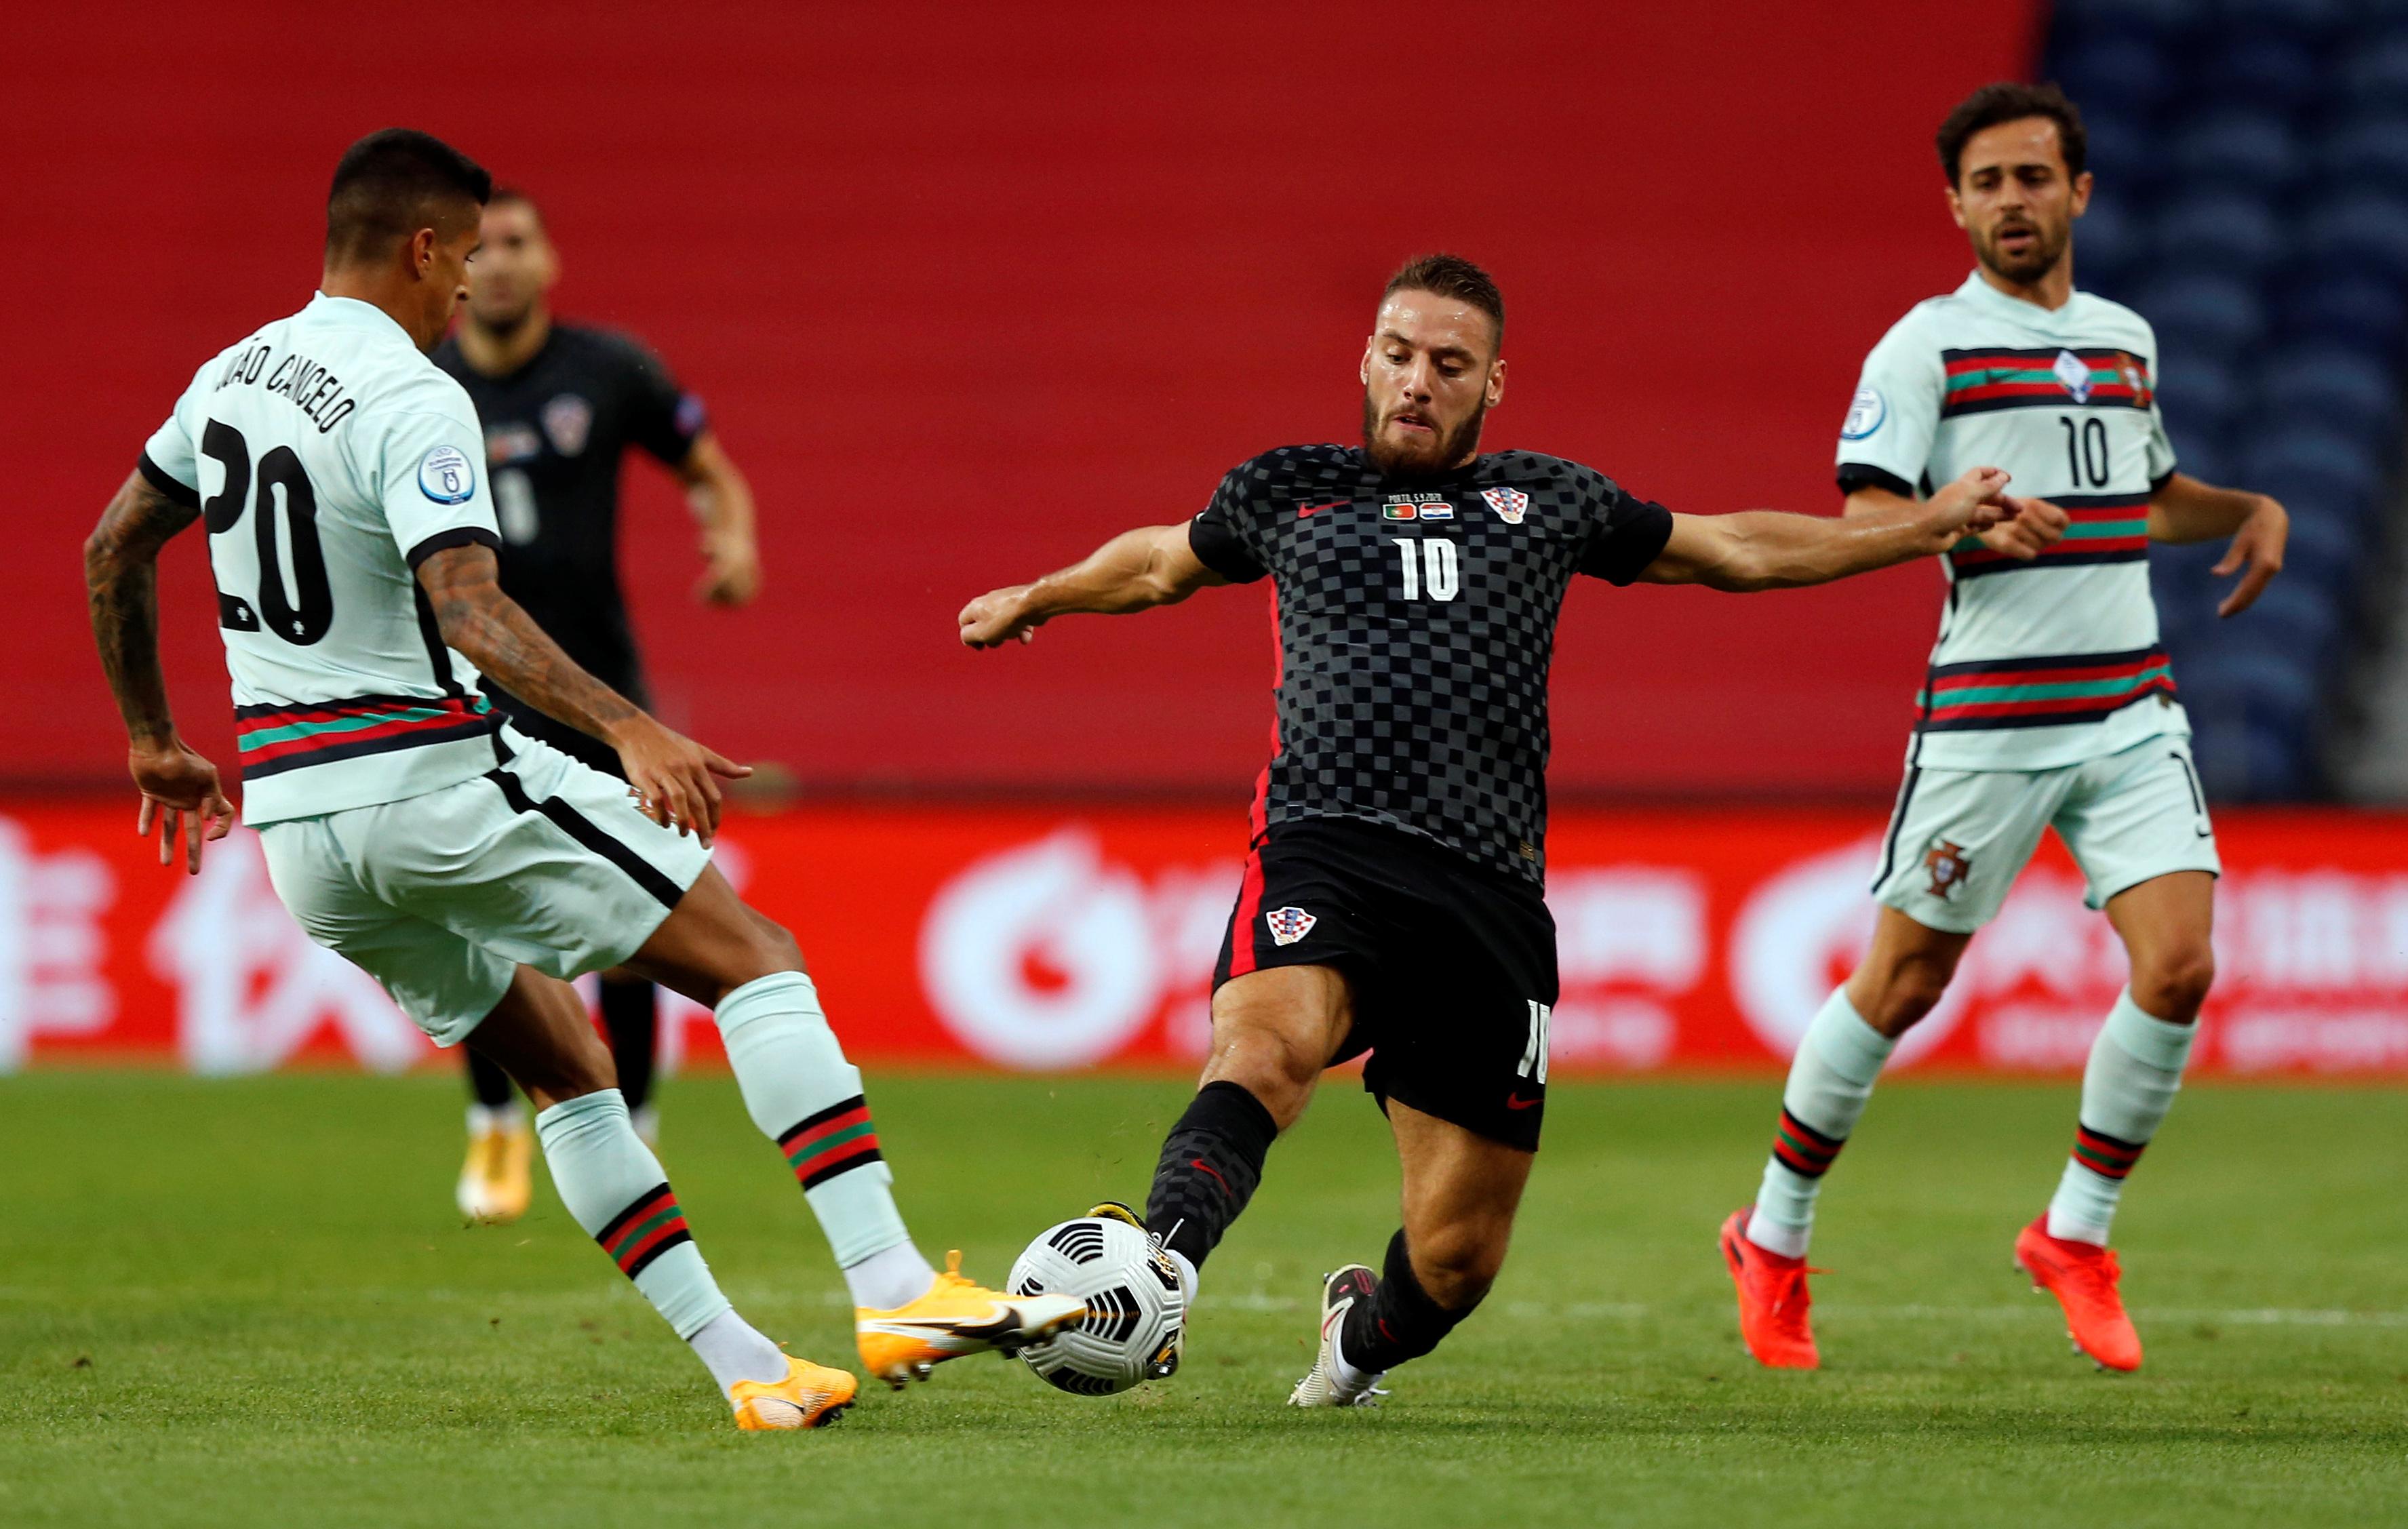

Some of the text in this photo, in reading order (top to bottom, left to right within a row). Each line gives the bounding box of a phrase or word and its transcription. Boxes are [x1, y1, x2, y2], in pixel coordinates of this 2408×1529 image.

[267, 354, 355, 433] CANCELO
[2060, 416, 2108, 487] 10
[202, 417, 333, 646] 20
[1391, 538, 1459, 601] 10
[1517, 999, 1550, 1085] 10
